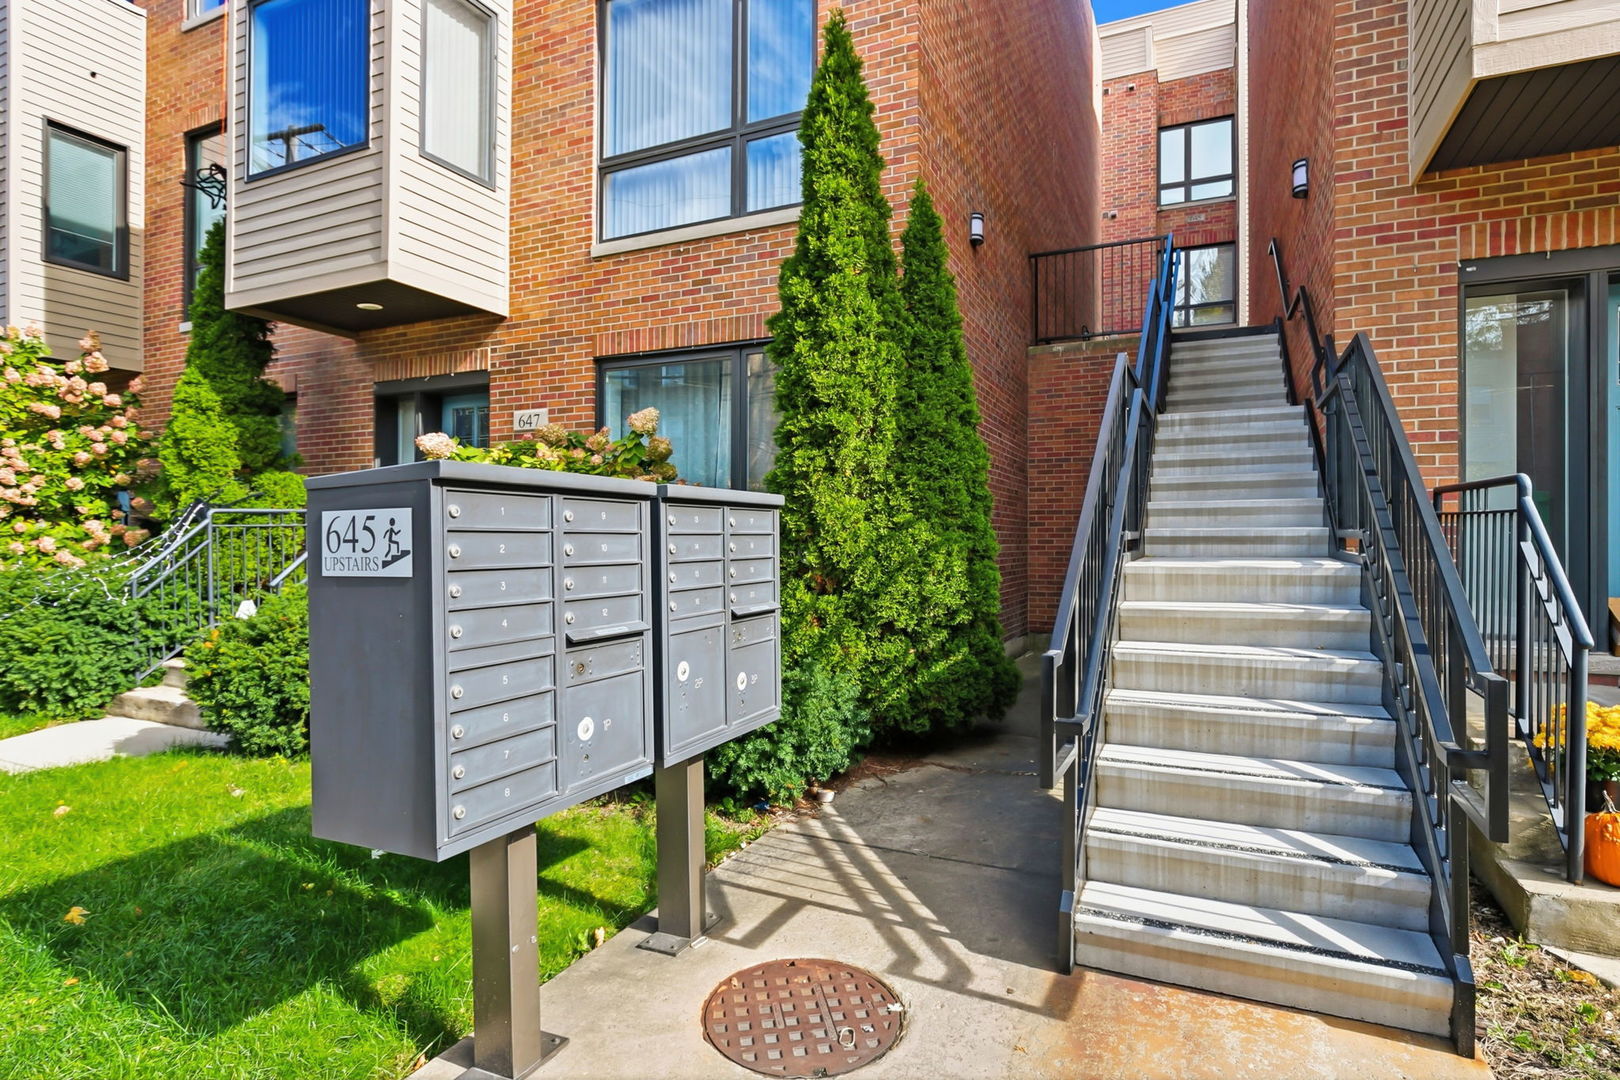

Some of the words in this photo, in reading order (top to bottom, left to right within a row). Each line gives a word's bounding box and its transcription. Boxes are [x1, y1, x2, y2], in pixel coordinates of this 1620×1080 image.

[518, 413, 540, 428] 647
[501, 507, 505, 515] 1
[601, 511, 606, 520] 9
[326, 515, 376, 554] 645
[500, 544, 505, 553] 2
[601, 543, 608, 552] 10
[324, 556, 379, 572] UPSTAIRS
[500, 581, 506, 591] 3
[502, 619, 508, 627] 4
[502, 675, 508, 684] 5
[503, 712, 509, 722] 6
[504, 750, 509, 759] 7
[504, 788, 510, 797] 8
